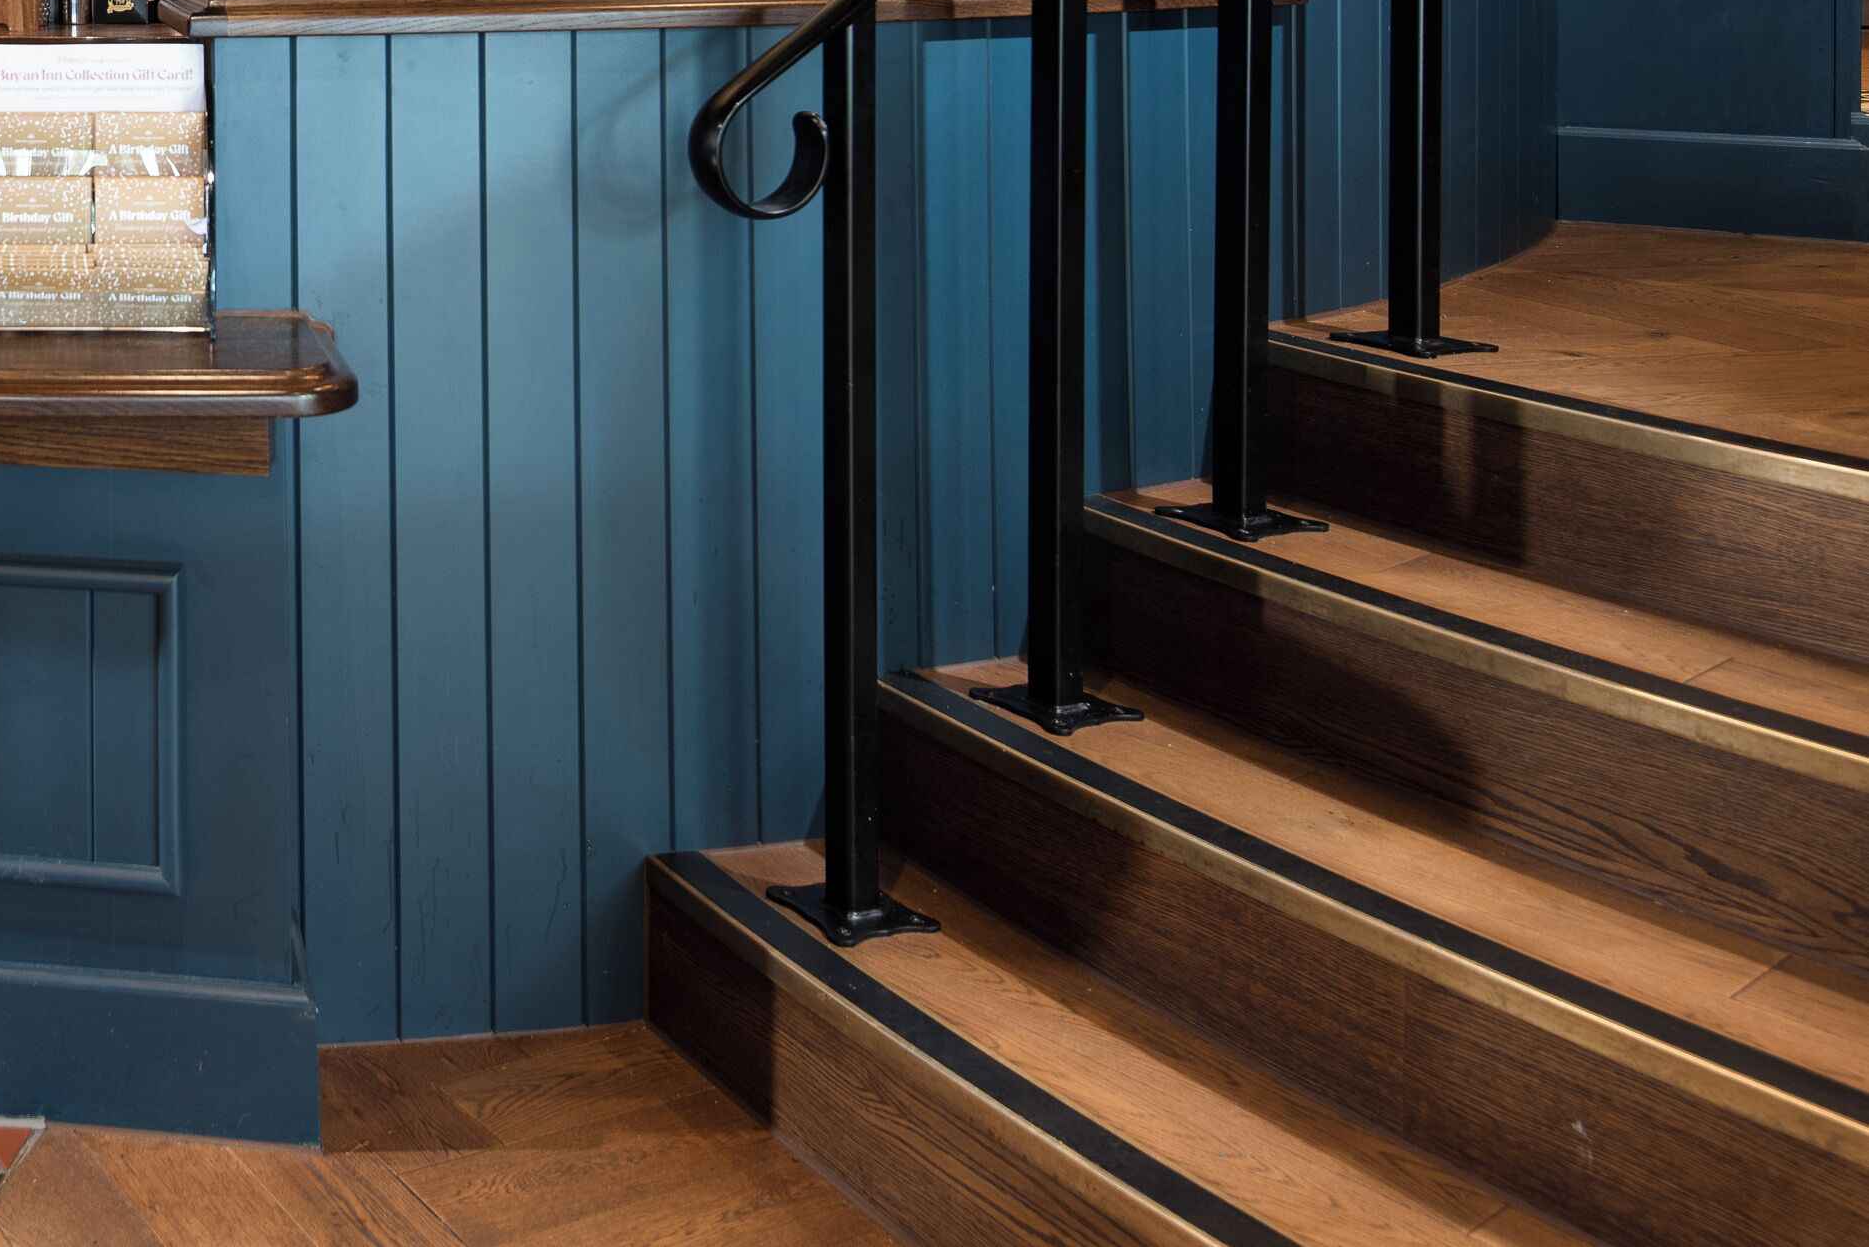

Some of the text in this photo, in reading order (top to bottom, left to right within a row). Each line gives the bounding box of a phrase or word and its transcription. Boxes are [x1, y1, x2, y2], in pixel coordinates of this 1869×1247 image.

[23, 72, 39, 80] an
[42, 69, 63, 80] Inn
[66, 69, 129, 81] Collection
[132, 69, 155, 80] Gift
[157, 69, 193, 80] Card!
[109, 144, 189, 156] A Birthday Gift
[2, 212, 51, 224] Birthday
[51, 212, 73, 222] Gift
[108, 210, 191, 222] A Birthday Gift
[8, 291, 58, 301] Birthday
[60, 291, 81, 300] Gift
[108, 292, 192, 303] A Birthday Gift
